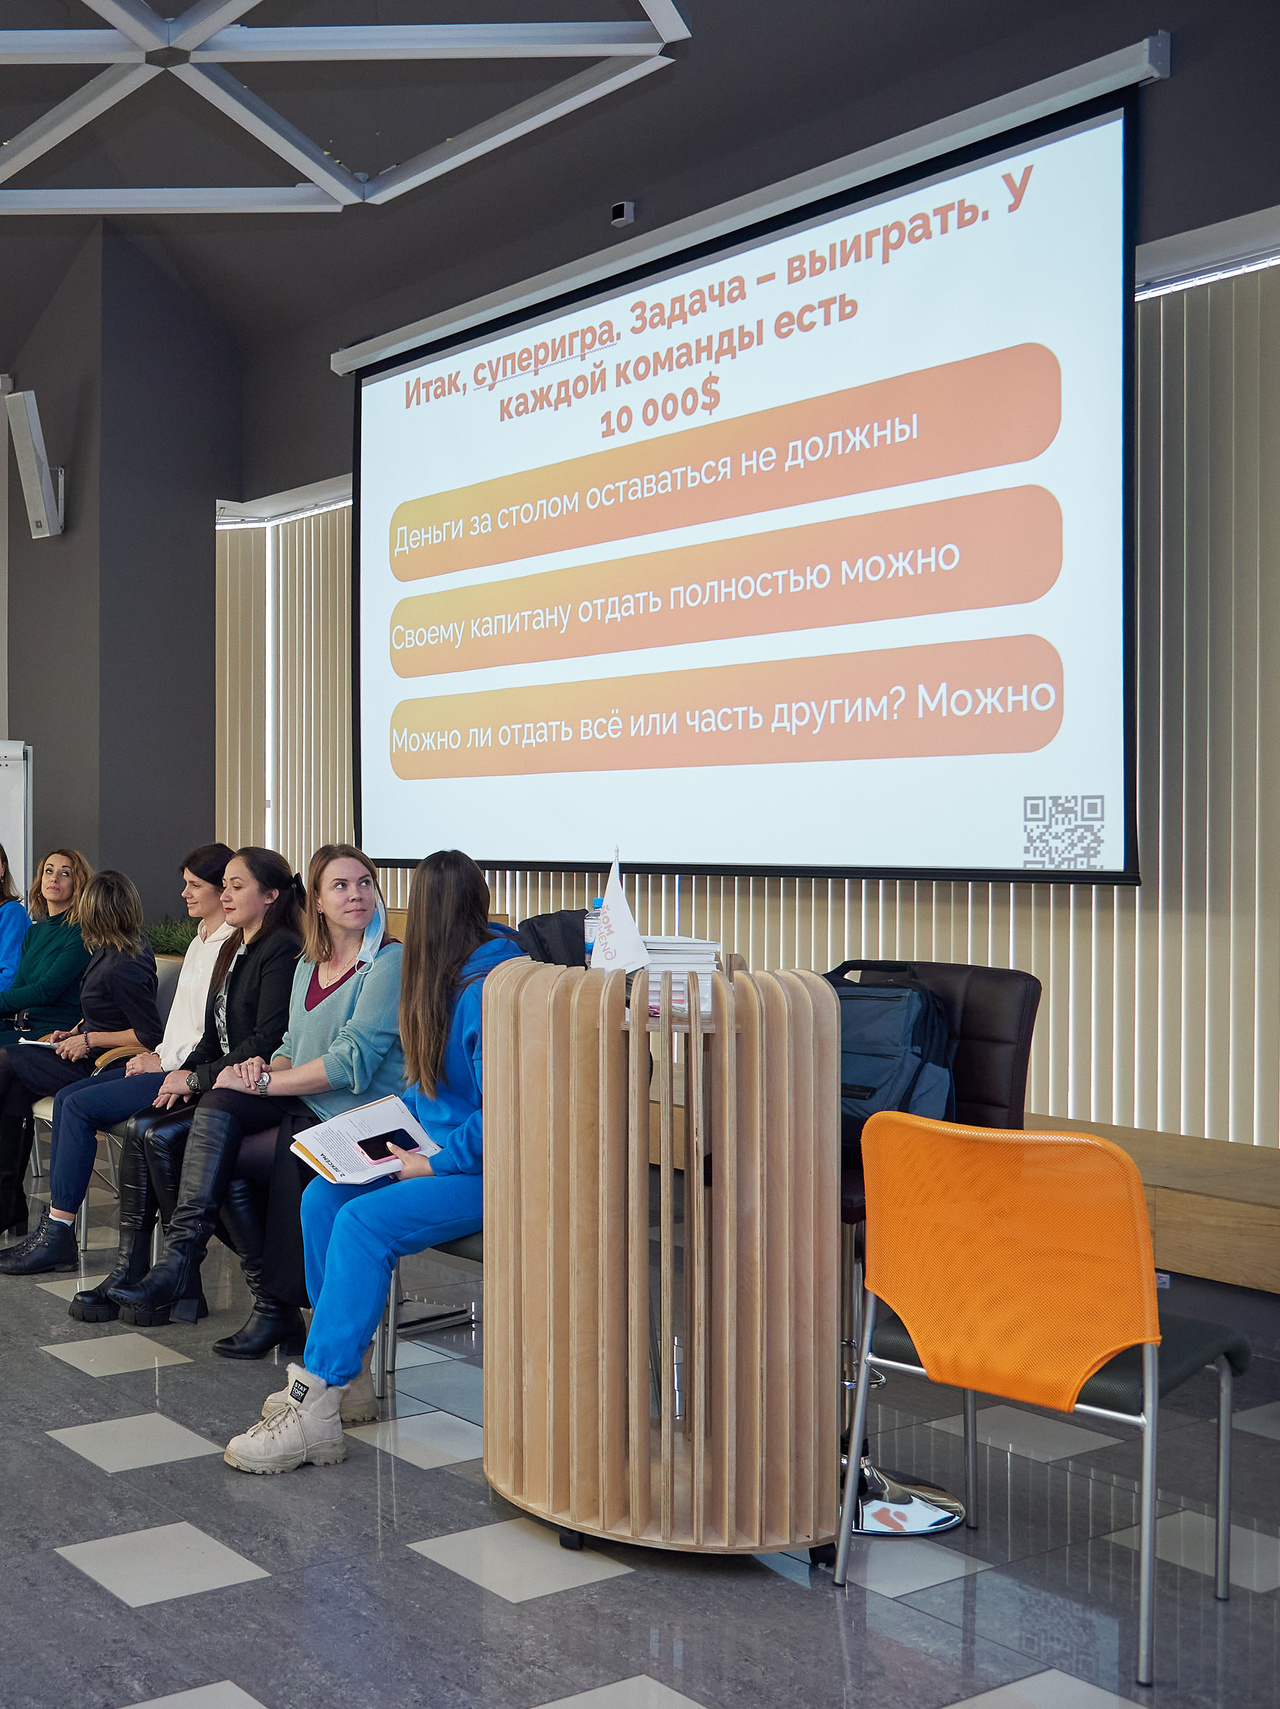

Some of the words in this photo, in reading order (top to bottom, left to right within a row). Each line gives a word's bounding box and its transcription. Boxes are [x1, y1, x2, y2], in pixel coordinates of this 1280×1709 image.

[407, 372, 466, 408] Итак,
[474, 321, 620, 390] суперигра.
[631, 276, 745, 333] Задача
[789, 200, 988, 284] выиграть.
[1003, 166, 1032, 212] У
[501, 354, 605, 420] каждой
[617, 320, 762, 386] команды
[775, 294, 857, 338] есть
[602, 406, 632, 437] 10
[643, 373, 720, 425] 000$
[394, 518, 464, 558] Деньги
[469, 512, 492, 536] за
[497, 491, 579, 530] столом
[586, 456, 732, 509] оставаться
[741, 446, 777, 477] не
[784, 412, 919, 472] должны
[392, 620, 465, 650] Своему
[471, 603, 572, 639] капитану
[578, 590, 664, 624] отдать
[670, 563, 831, 610] полностью
[841, 543, 960, 586] можно
[392, 727, 462, 753] Можно
[466, 726, 492, 749] ли
[497, 721, 573, 749] отдать
[580, 707, 623, 742] всё
[630, 706, 678, 737] или
[685, 704, 763, 734] часть
[771, 686, 906, 736] другим?
[918, 679, 1057, 719] Можно
